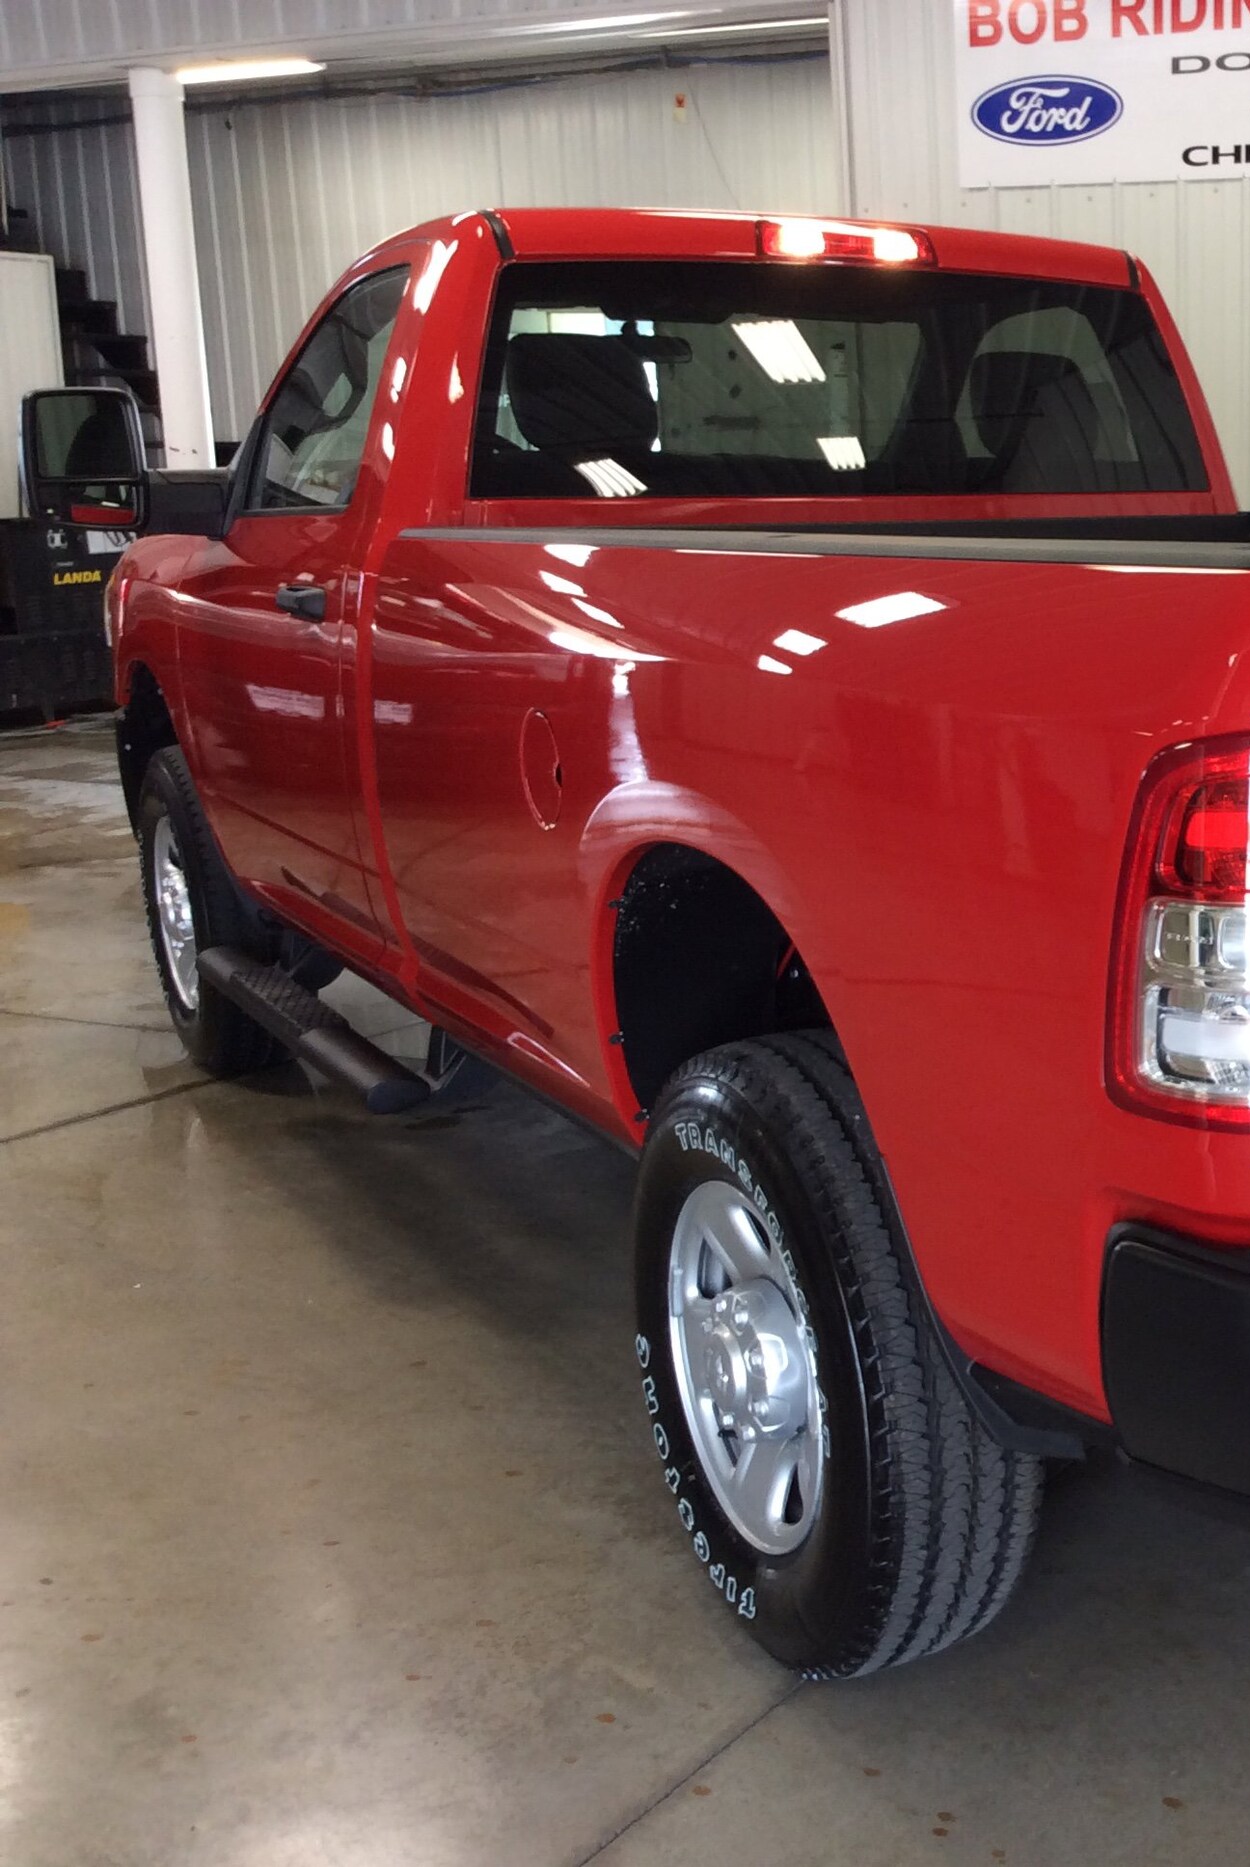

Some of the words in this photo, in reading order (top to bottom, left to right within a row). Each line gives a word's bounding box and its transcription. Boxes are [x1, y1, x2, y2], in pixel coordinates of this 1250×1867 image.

[969, 0, 1088, 47] BOB
[1002, 87, 1091, 133] Ford
[53, 571, 101, 586] LANDA
